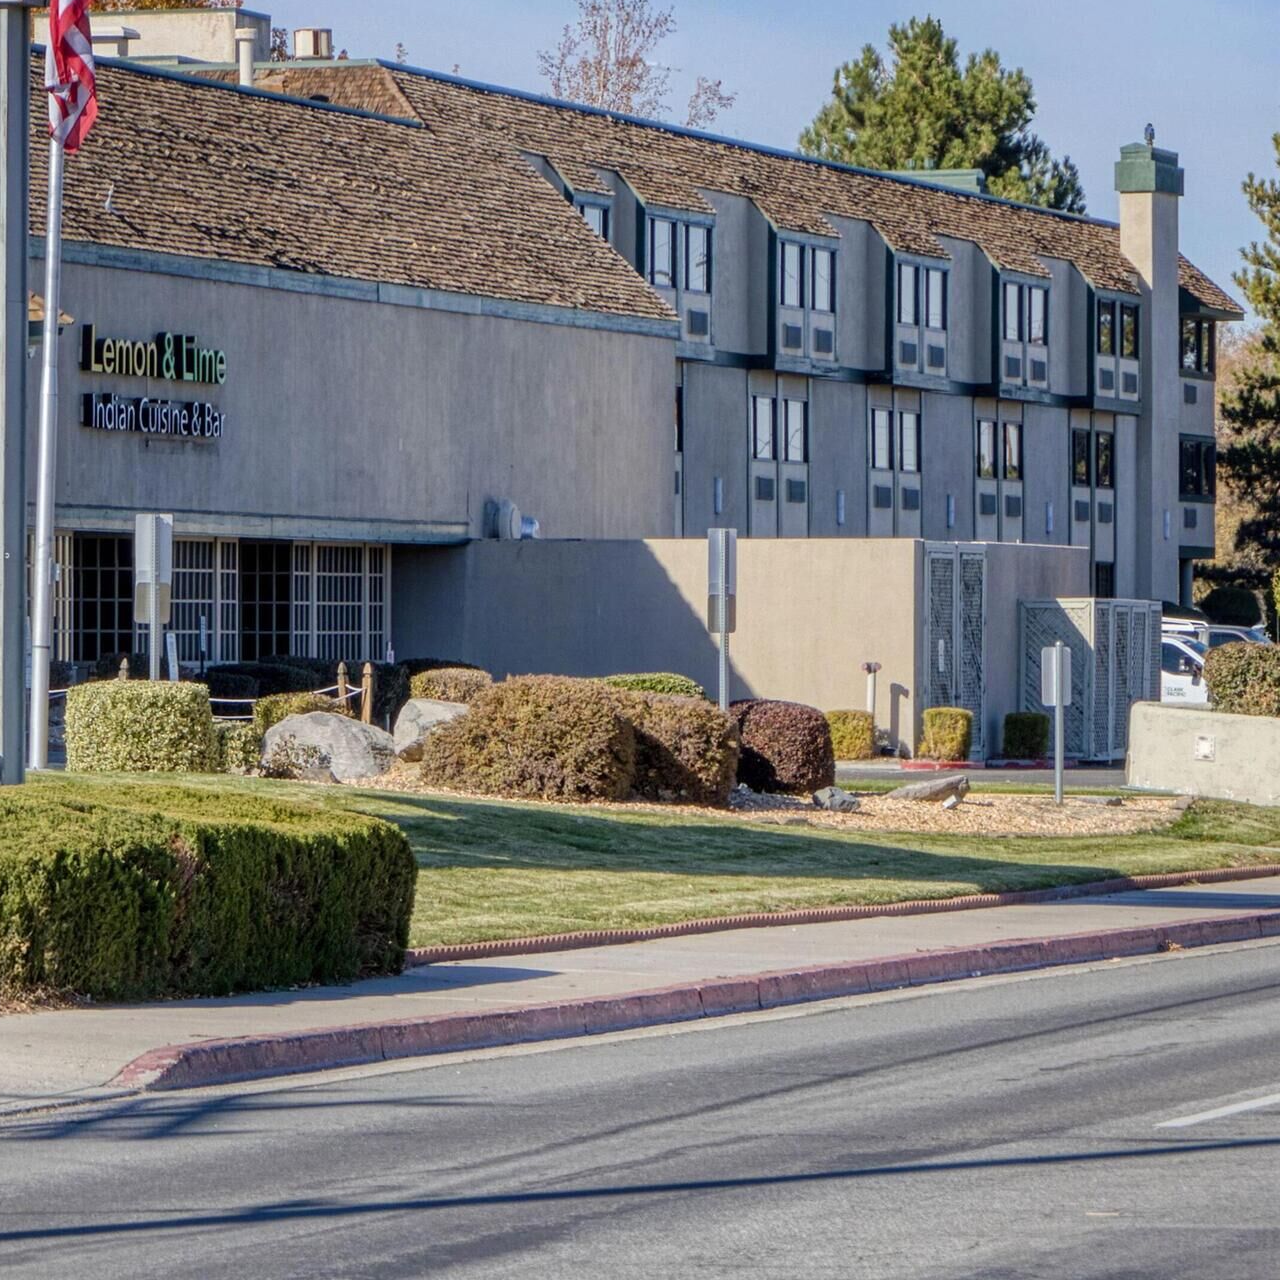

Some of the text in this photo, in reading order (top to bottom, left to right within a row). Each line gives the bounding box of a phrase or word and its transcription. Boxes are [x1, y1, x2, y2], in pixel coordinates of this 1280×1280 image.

[90, 324, 227, 384] Lemon & Lime
[91, 393, 226, 437] Indian Cuisine & Bar
